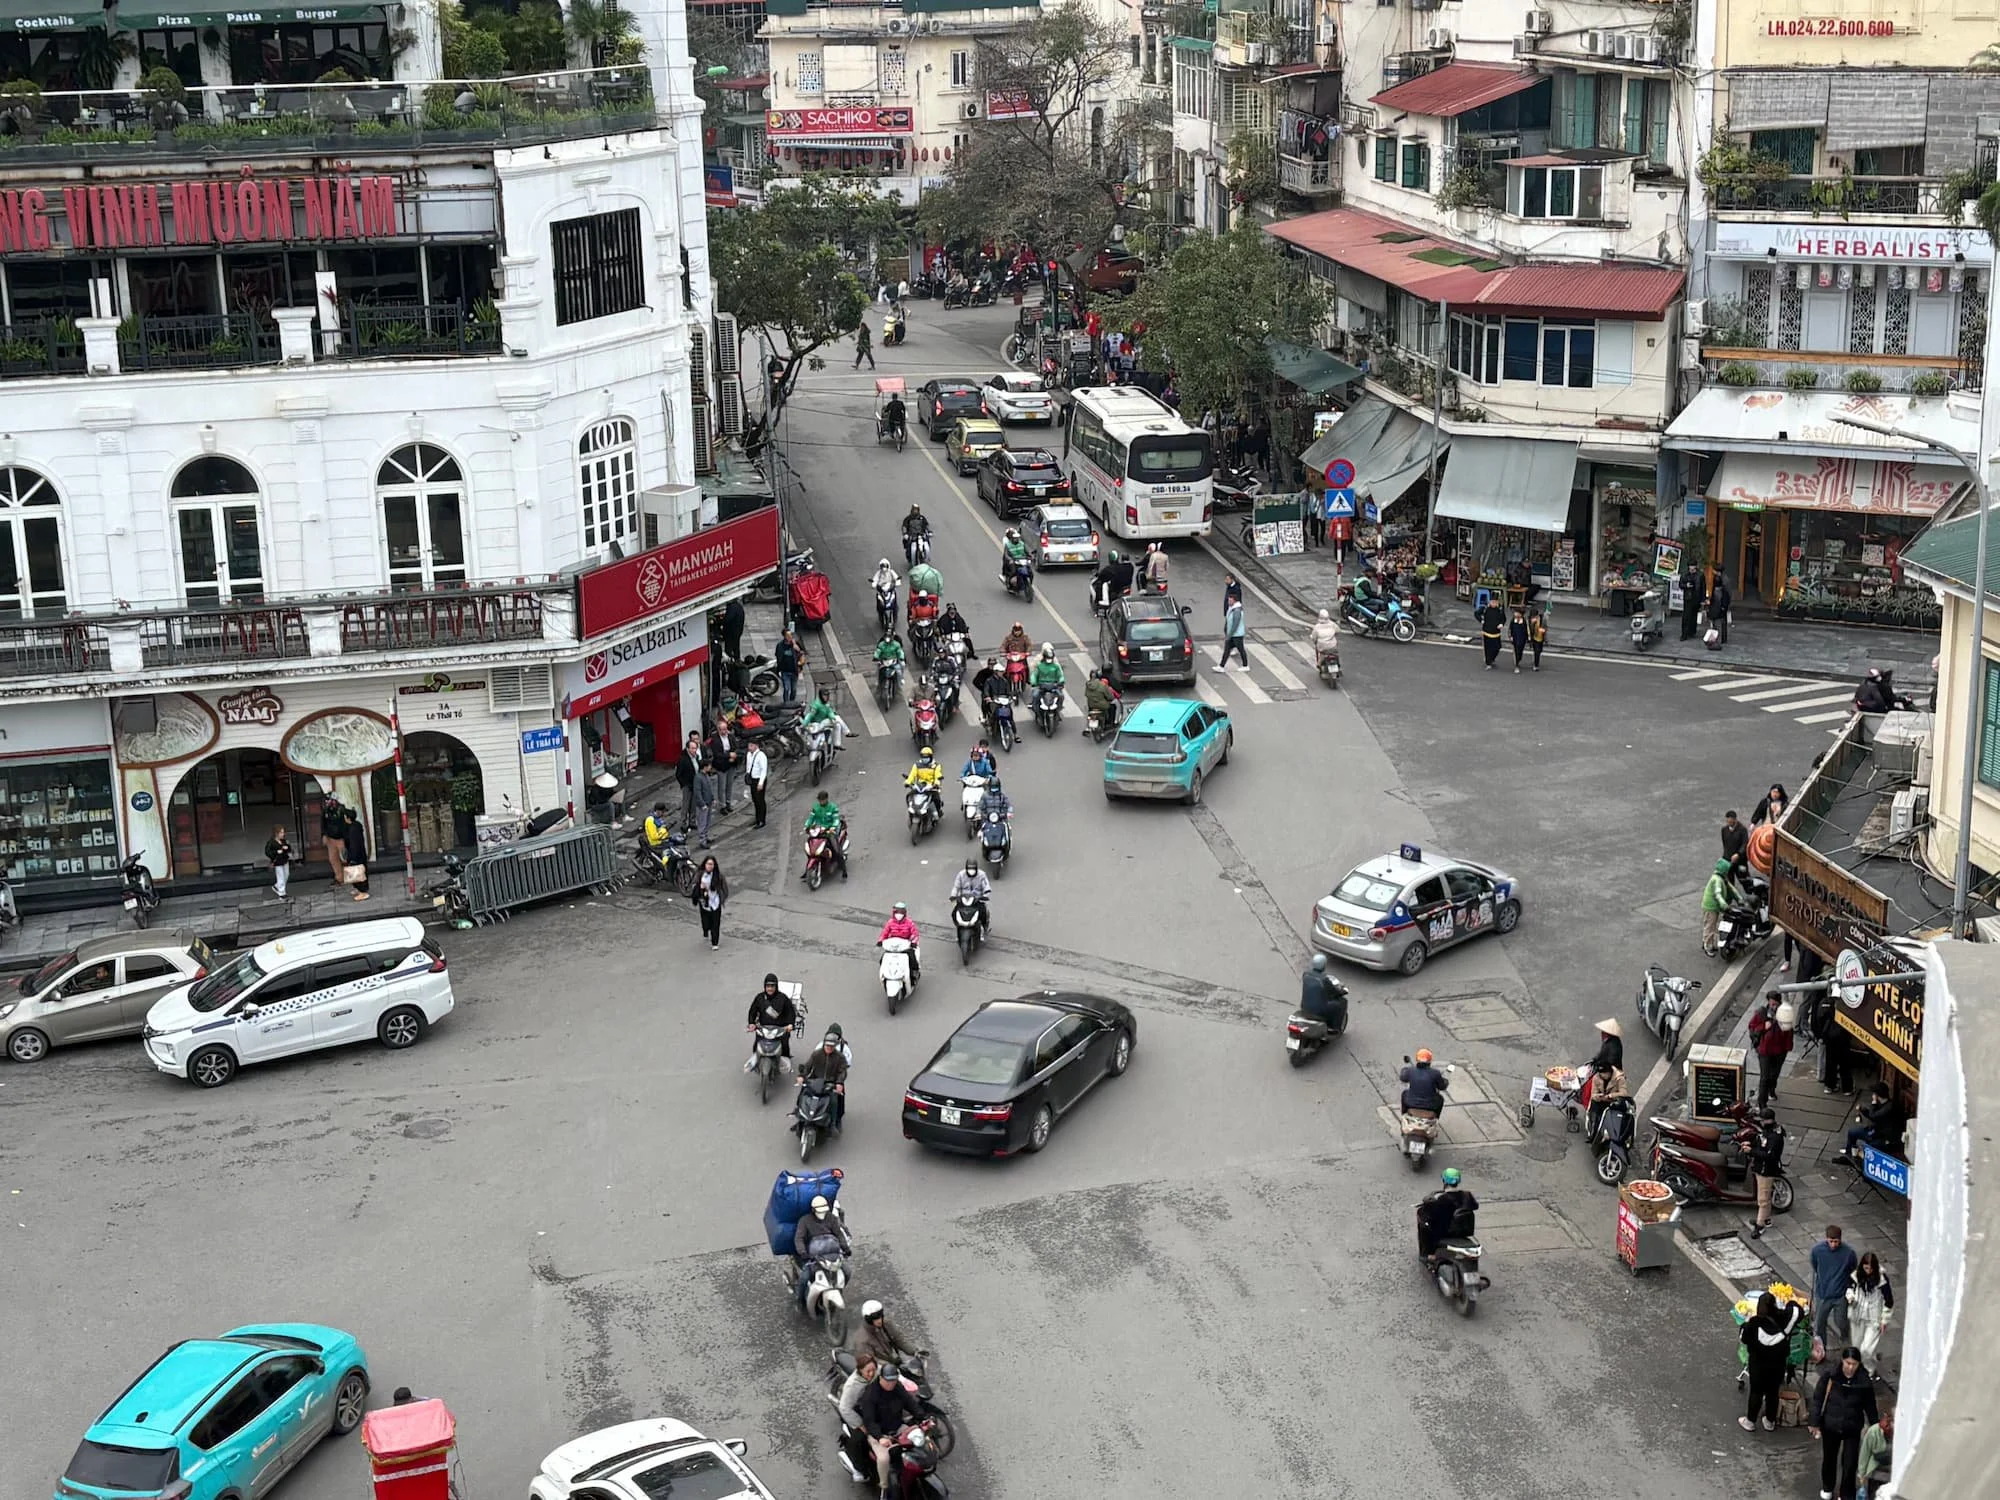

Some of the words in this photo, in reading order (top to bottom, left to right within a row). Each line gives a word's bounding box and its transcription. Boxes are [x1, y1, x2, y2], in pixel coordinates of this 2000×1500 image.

[15, 16, 75, 29] Cocktails
[158, 14, 191, 26] Pizza
[226, 11, 262, 23] Pasta
[295, 8, 338, 21] Burger
[1767, 20, 1894, 37] LH.024.22.600.600
[807, 110, 871, 125] SACHIKO
[63, 184, 162, 250] VINH
[172, 164, 294, 244] MUÔN
[304, 160, 397, 241] NĂM
[1797, 239, 1949, 259] HERBALIST
[669, 539, 733, 578] MANWAH
[670, 567, 708, 589] TAIWANESE
[708, 558, 734, 576] HOTPOT
[611, 620, 688, 667] SeABank
[632, 677, 645, 688] ATM
